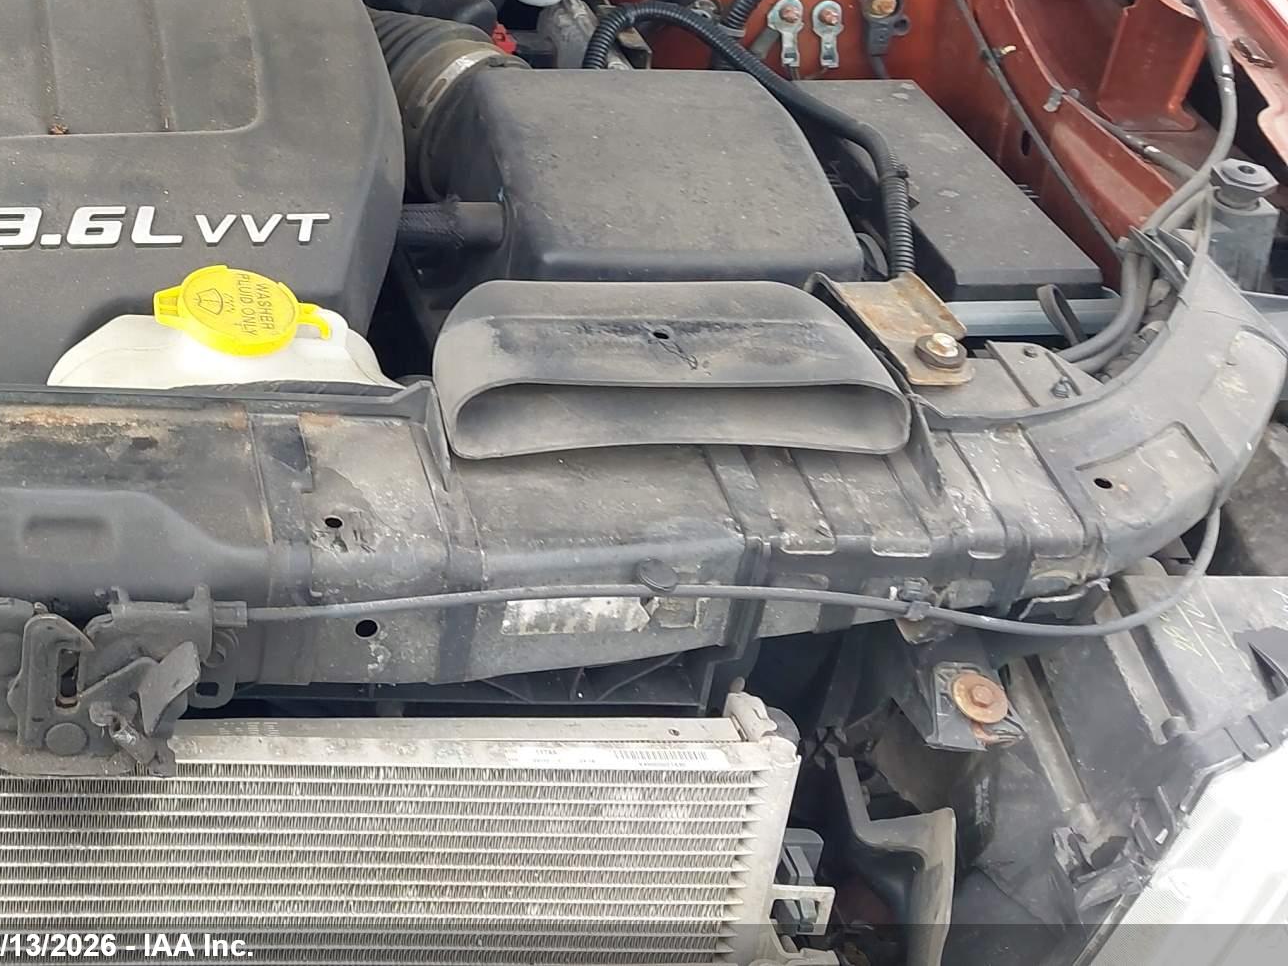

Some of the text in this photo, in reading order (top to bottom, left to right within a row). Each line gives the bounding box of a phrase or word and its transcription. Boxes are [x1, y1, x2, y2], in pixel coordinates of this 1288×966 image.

[195, 213, 331, 244] VVT
[241, 308, 257, 336] ONLY
[255, 283, 275, 331] WASHER
